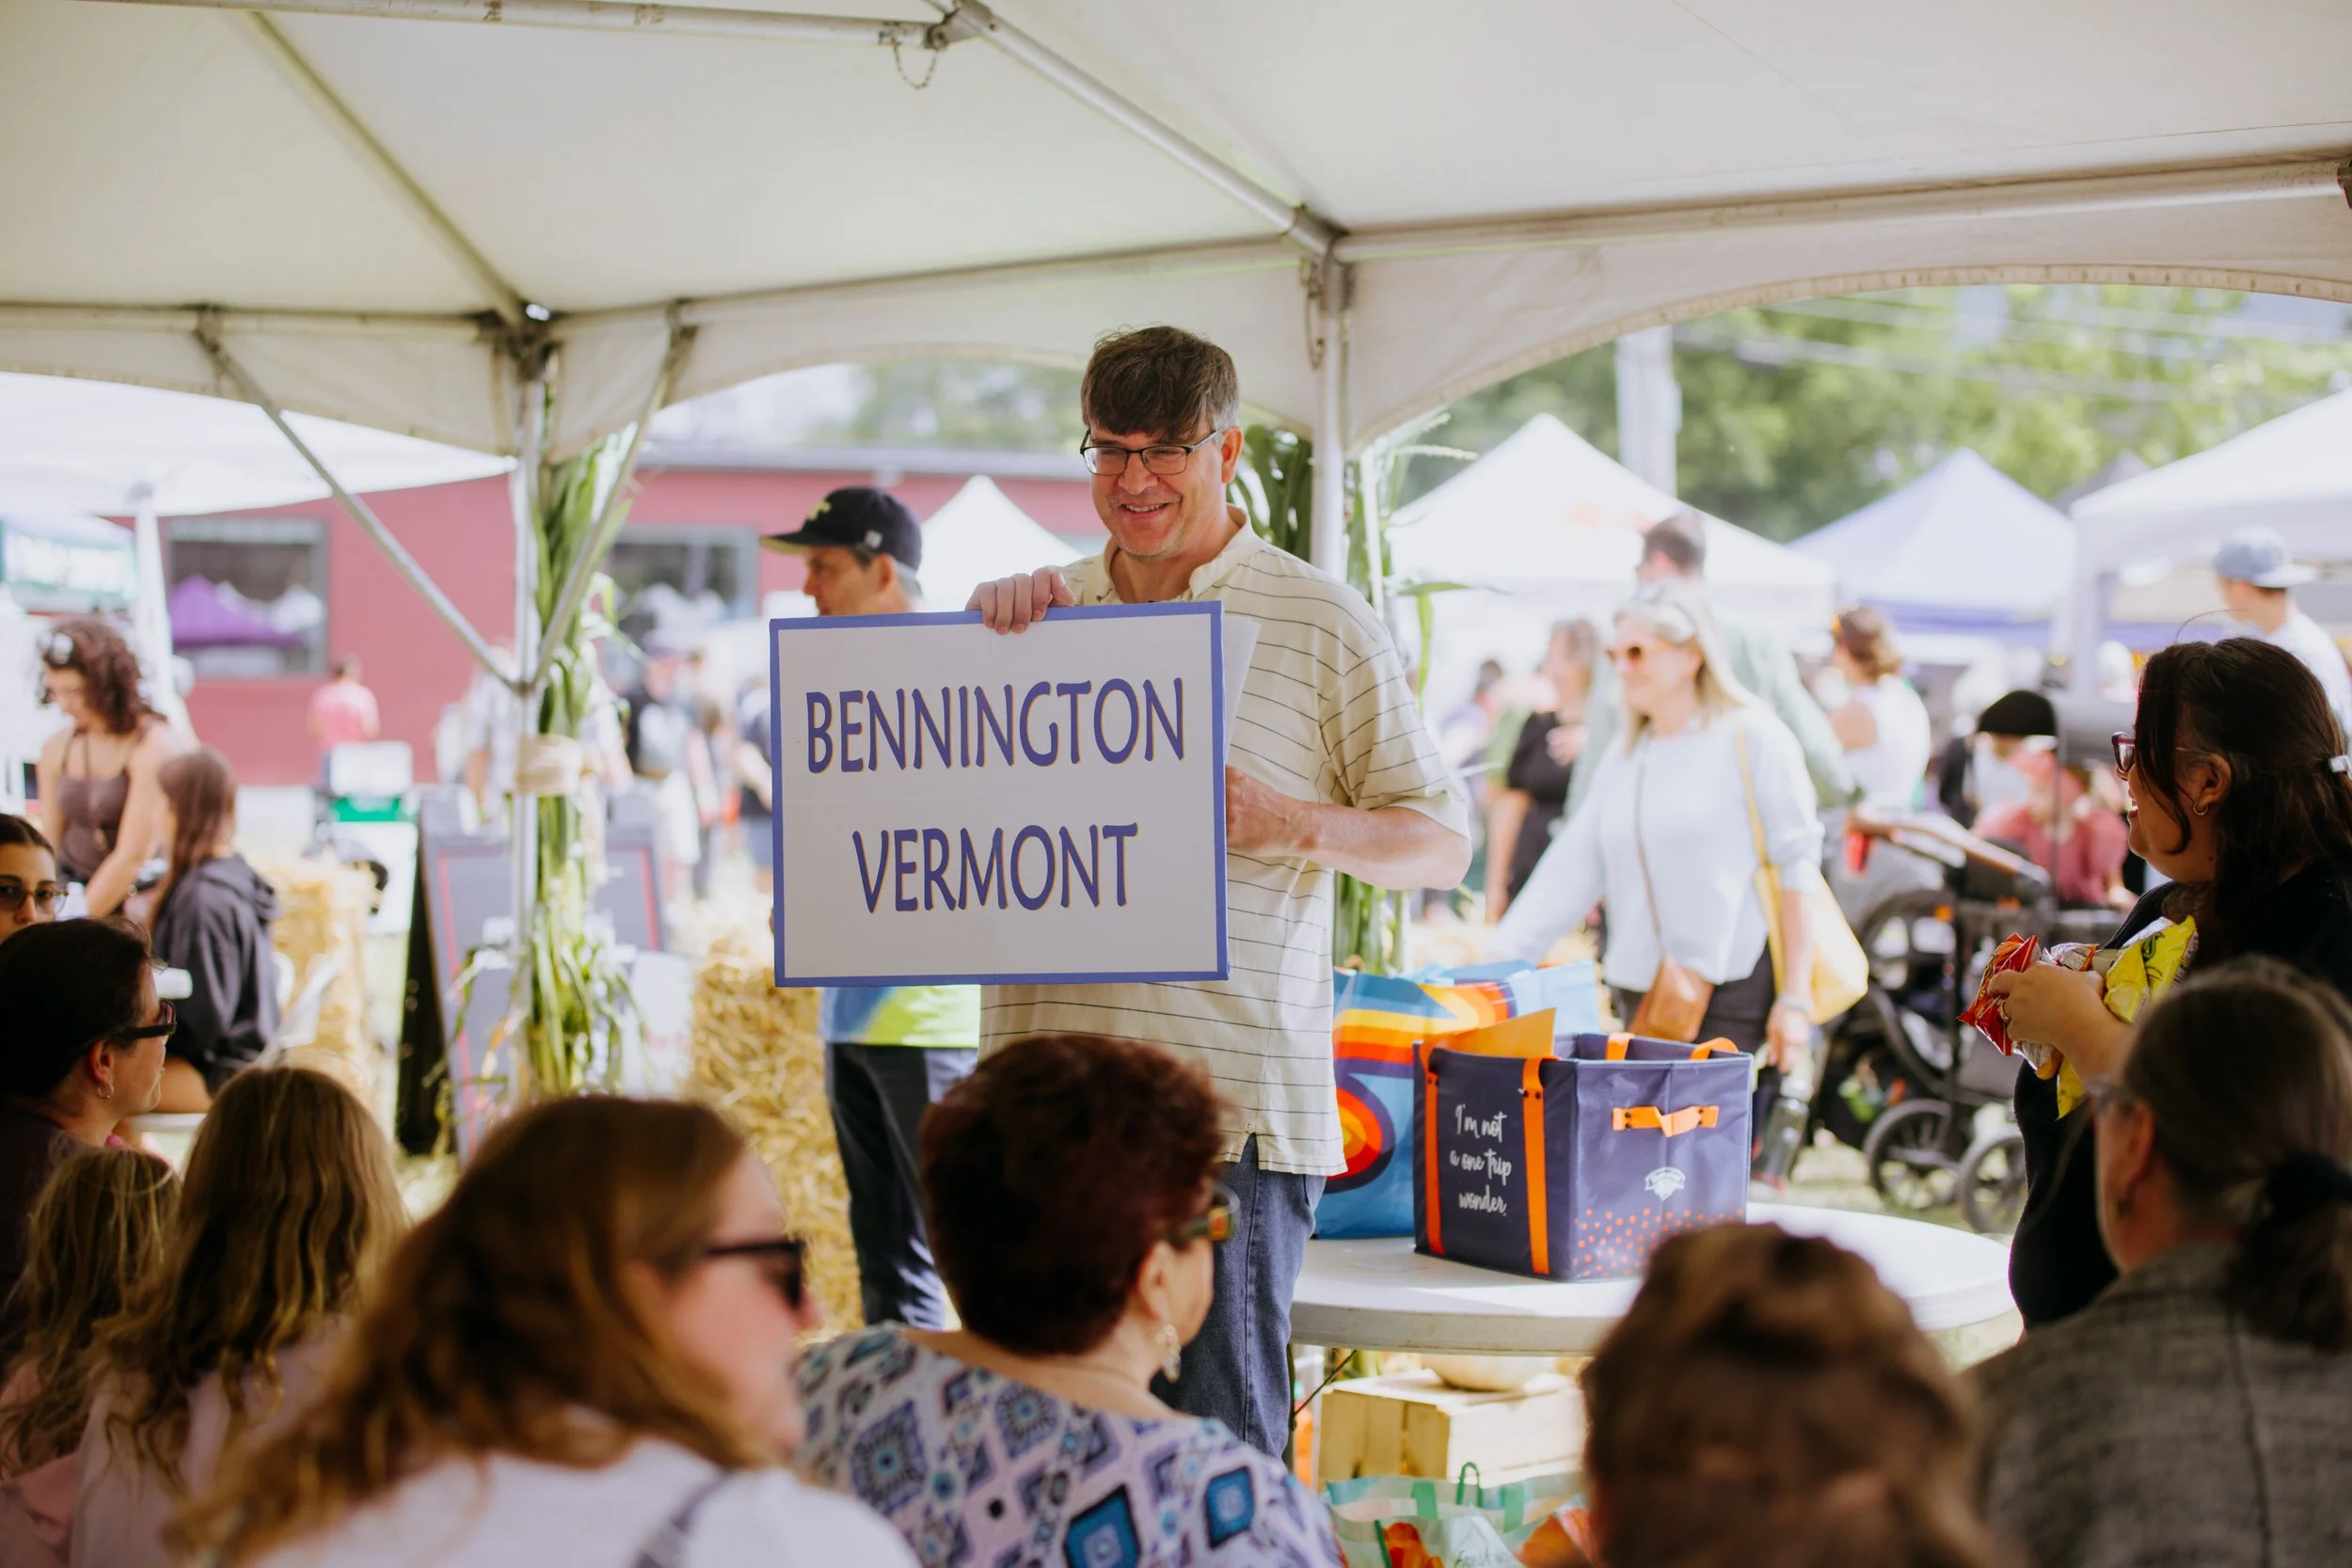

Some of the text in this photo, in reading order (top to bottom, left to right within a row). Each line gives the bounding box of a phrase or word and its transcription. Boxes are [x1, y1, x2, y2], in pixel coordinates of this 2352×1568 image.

[806, 677, 1184, 774] BENNINGTON
[852, 822, 1138, 913] VERMONT
[1454, 1103, 1507, 1143] I'm not
[1450, 1148, 1512, 1186] a one trip
